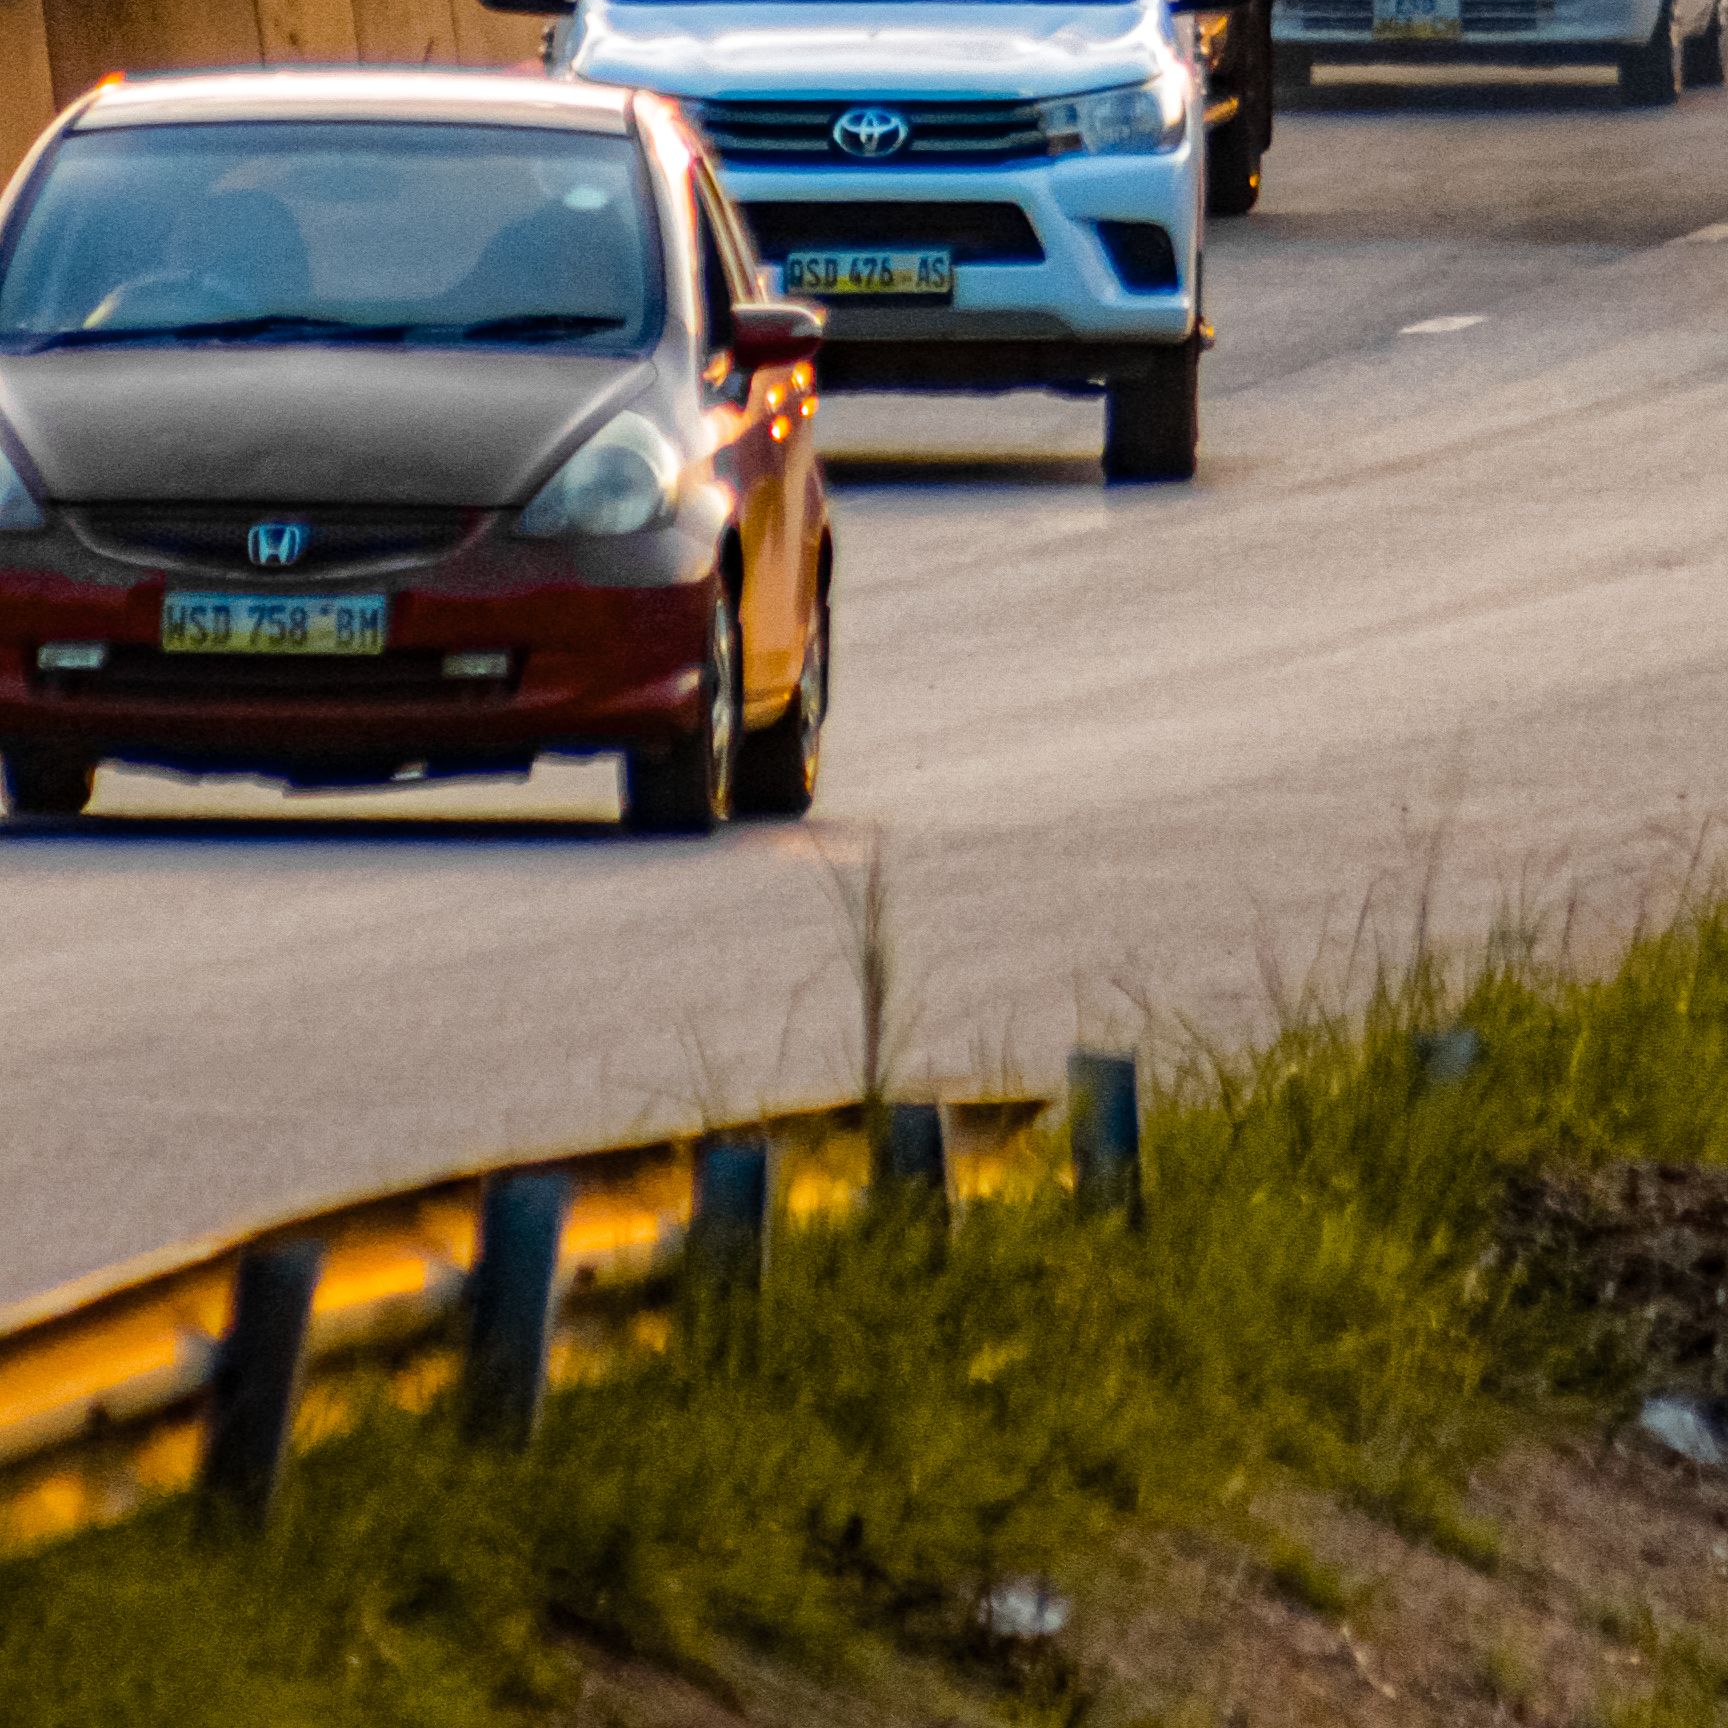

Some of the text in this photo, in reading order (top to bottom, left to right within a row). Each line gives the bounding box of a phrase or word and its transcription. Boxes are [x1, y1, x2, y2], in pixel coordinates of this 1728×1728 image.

[849, 256, 894, 288] 476
[917, 256, 945, 288] AS
[248, 604, 308, 647] 758
[336, 607, 379, 647] BM
